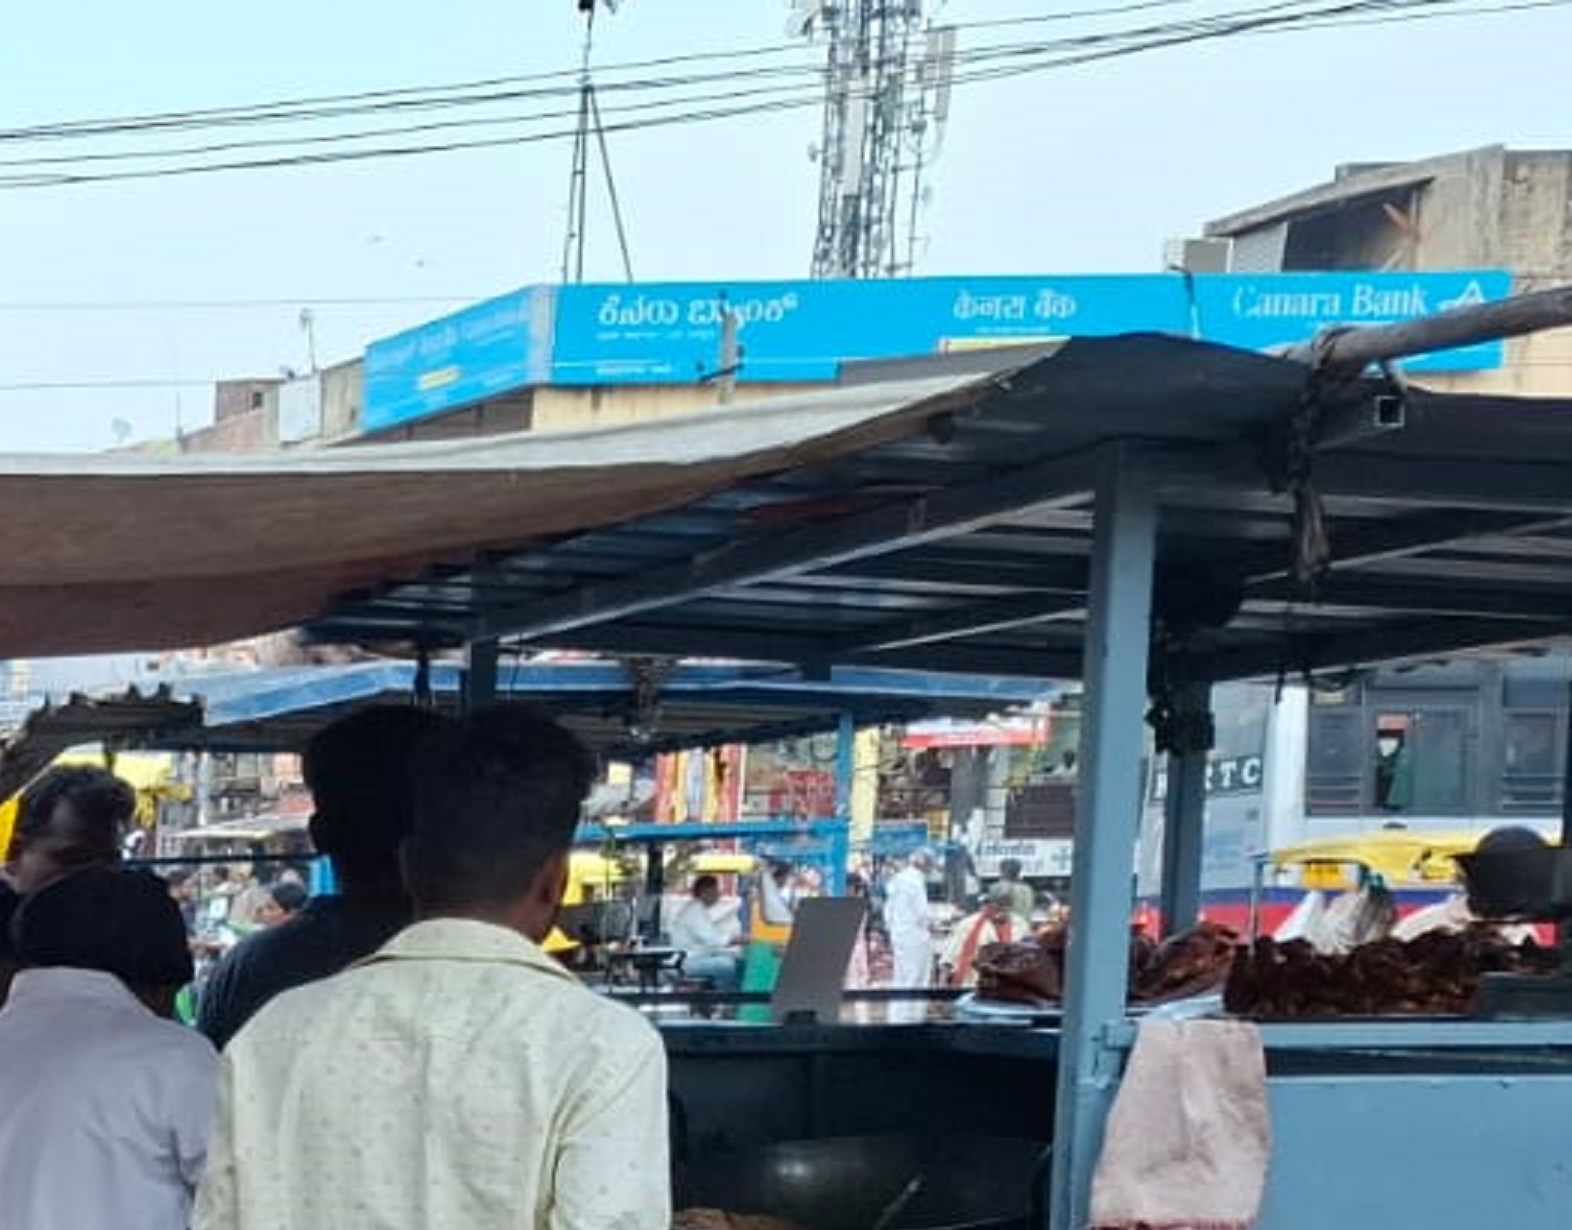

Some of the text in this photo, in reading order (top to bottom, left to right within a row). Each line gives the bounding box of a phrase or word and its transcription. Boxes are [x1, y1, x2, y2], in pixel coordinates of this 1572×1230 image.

[953, 287, 1078, 320] केनरा बैंक
[1233, 283, 1428, 317] Canara Bank
